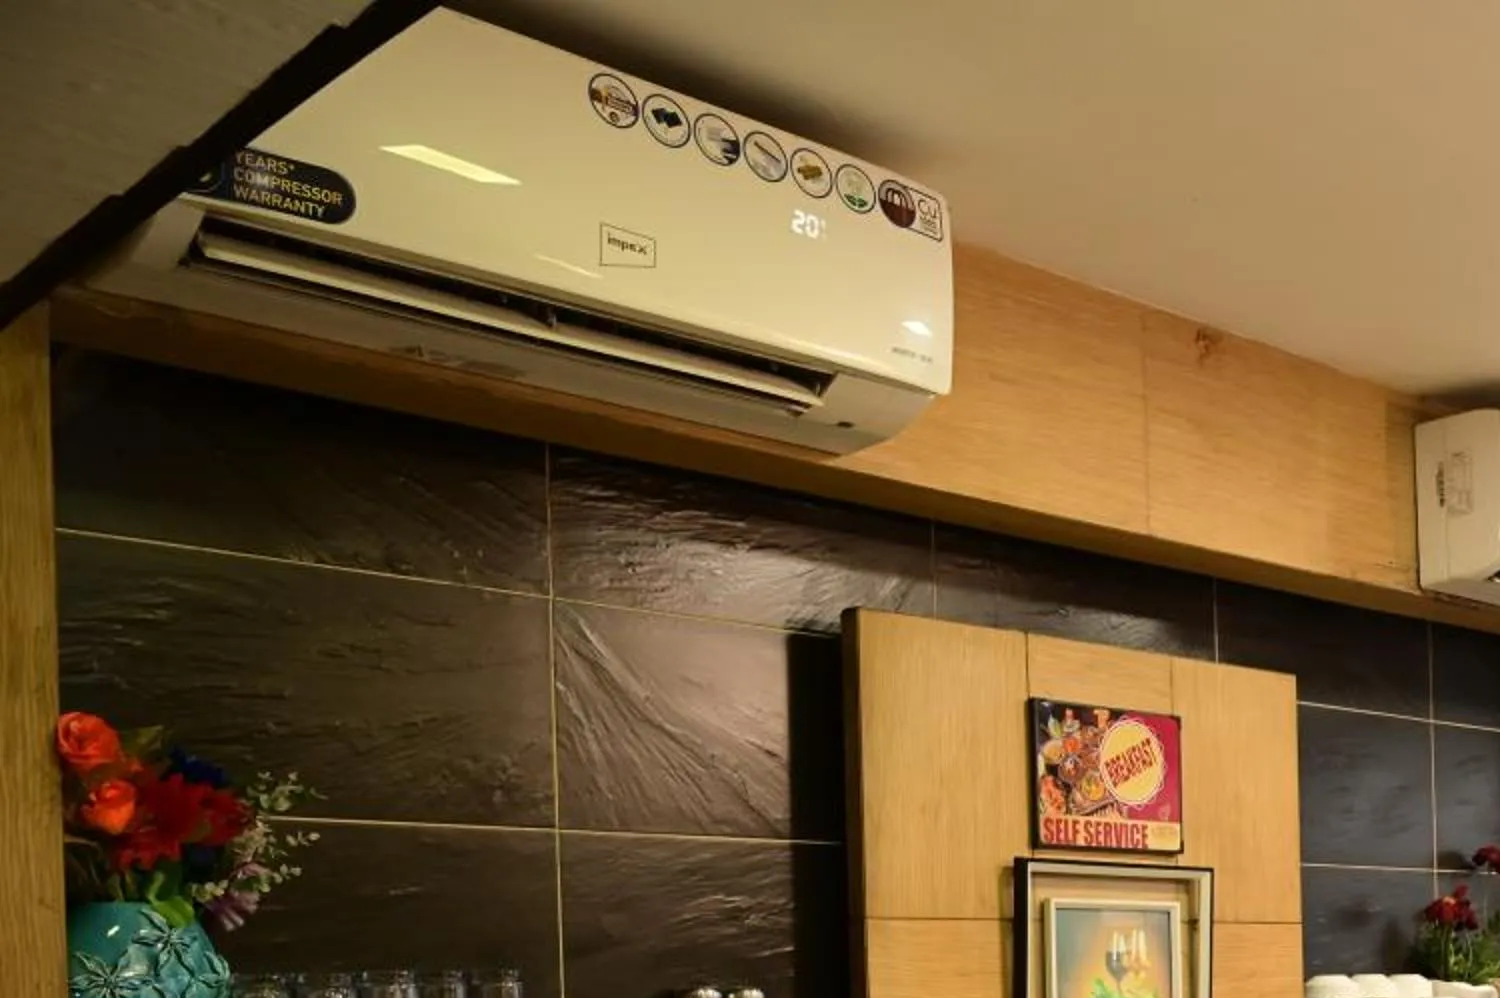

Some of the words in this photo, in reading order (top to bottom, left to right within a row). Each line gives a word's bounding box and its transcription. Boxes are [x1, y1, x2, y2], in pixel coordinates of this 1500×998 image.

[233, 166, 344, 204] COMPRESSOR
[233, 184, 327, 218] WARRANTY
[1043, 817, 1081, 844] SELF
[1083, 819, 1149, 850] SERVICE
